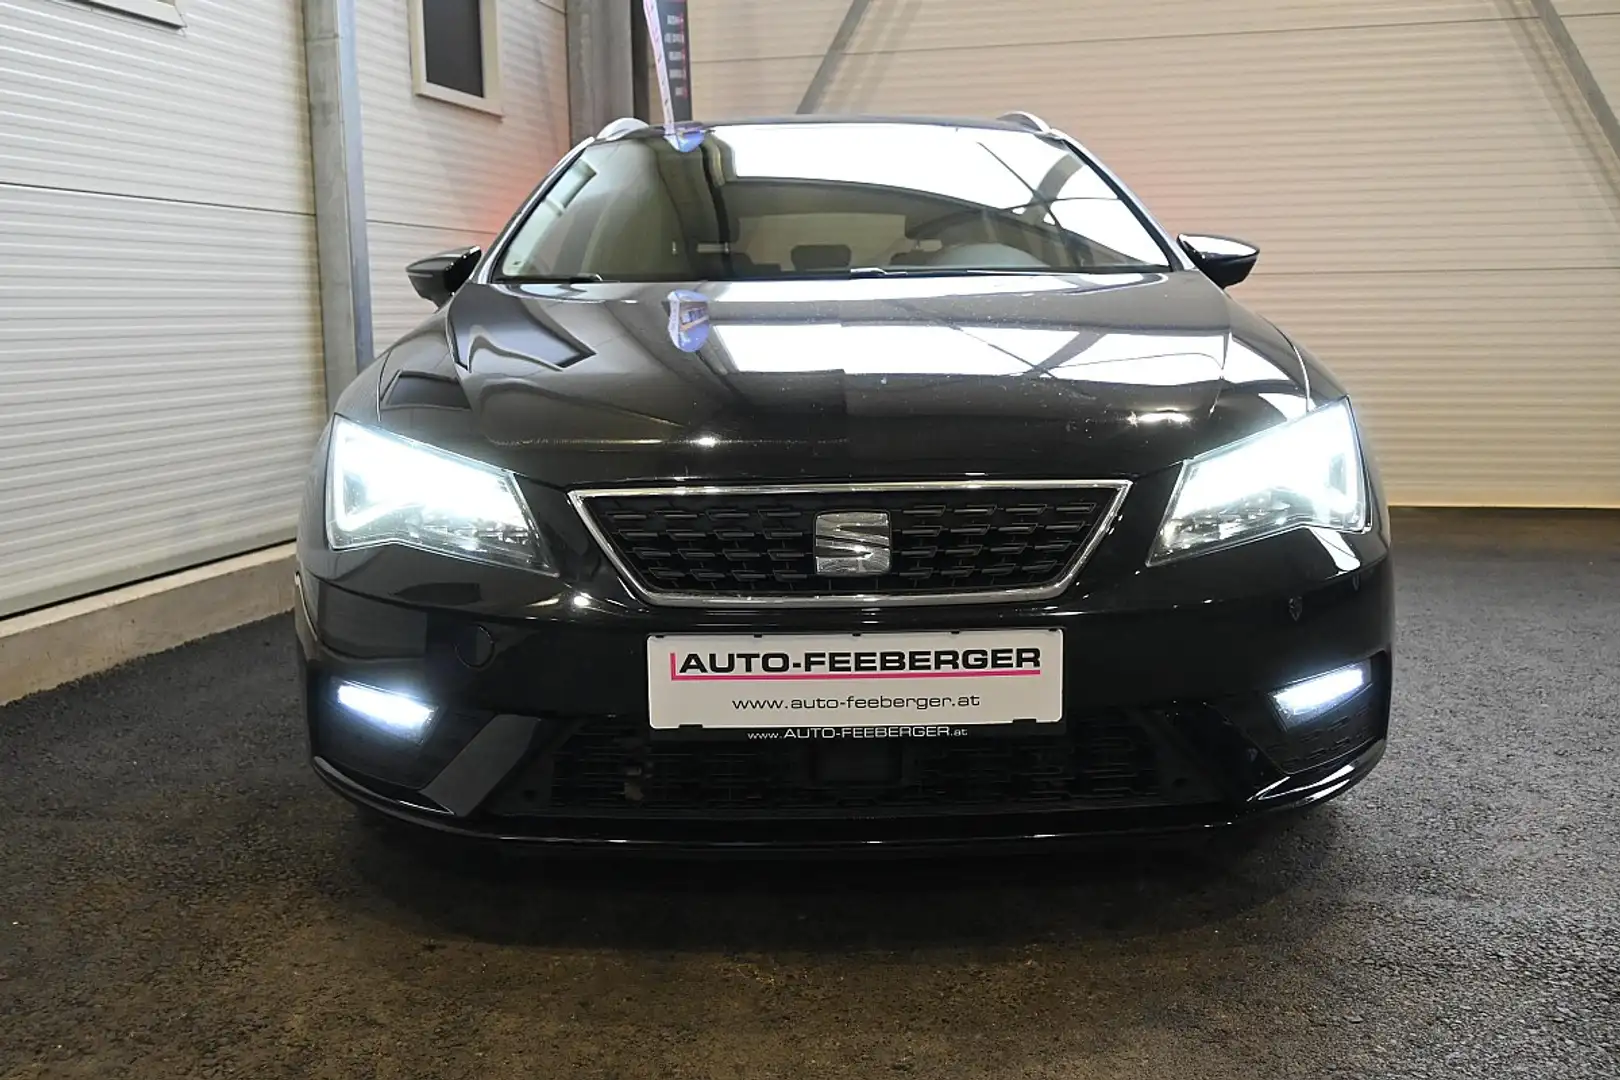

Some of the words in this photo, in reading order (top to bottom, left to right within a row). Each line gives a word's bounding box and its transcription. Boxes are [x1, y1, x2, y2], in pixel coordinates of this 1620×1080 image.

[679, 648, 1041, 673] AUTO-FEEBERGER
[732, 694, 981, 711] www.auto-feeberger.at
[747, 726, 968, 741] www.AUTO-FEEBERGER.at
